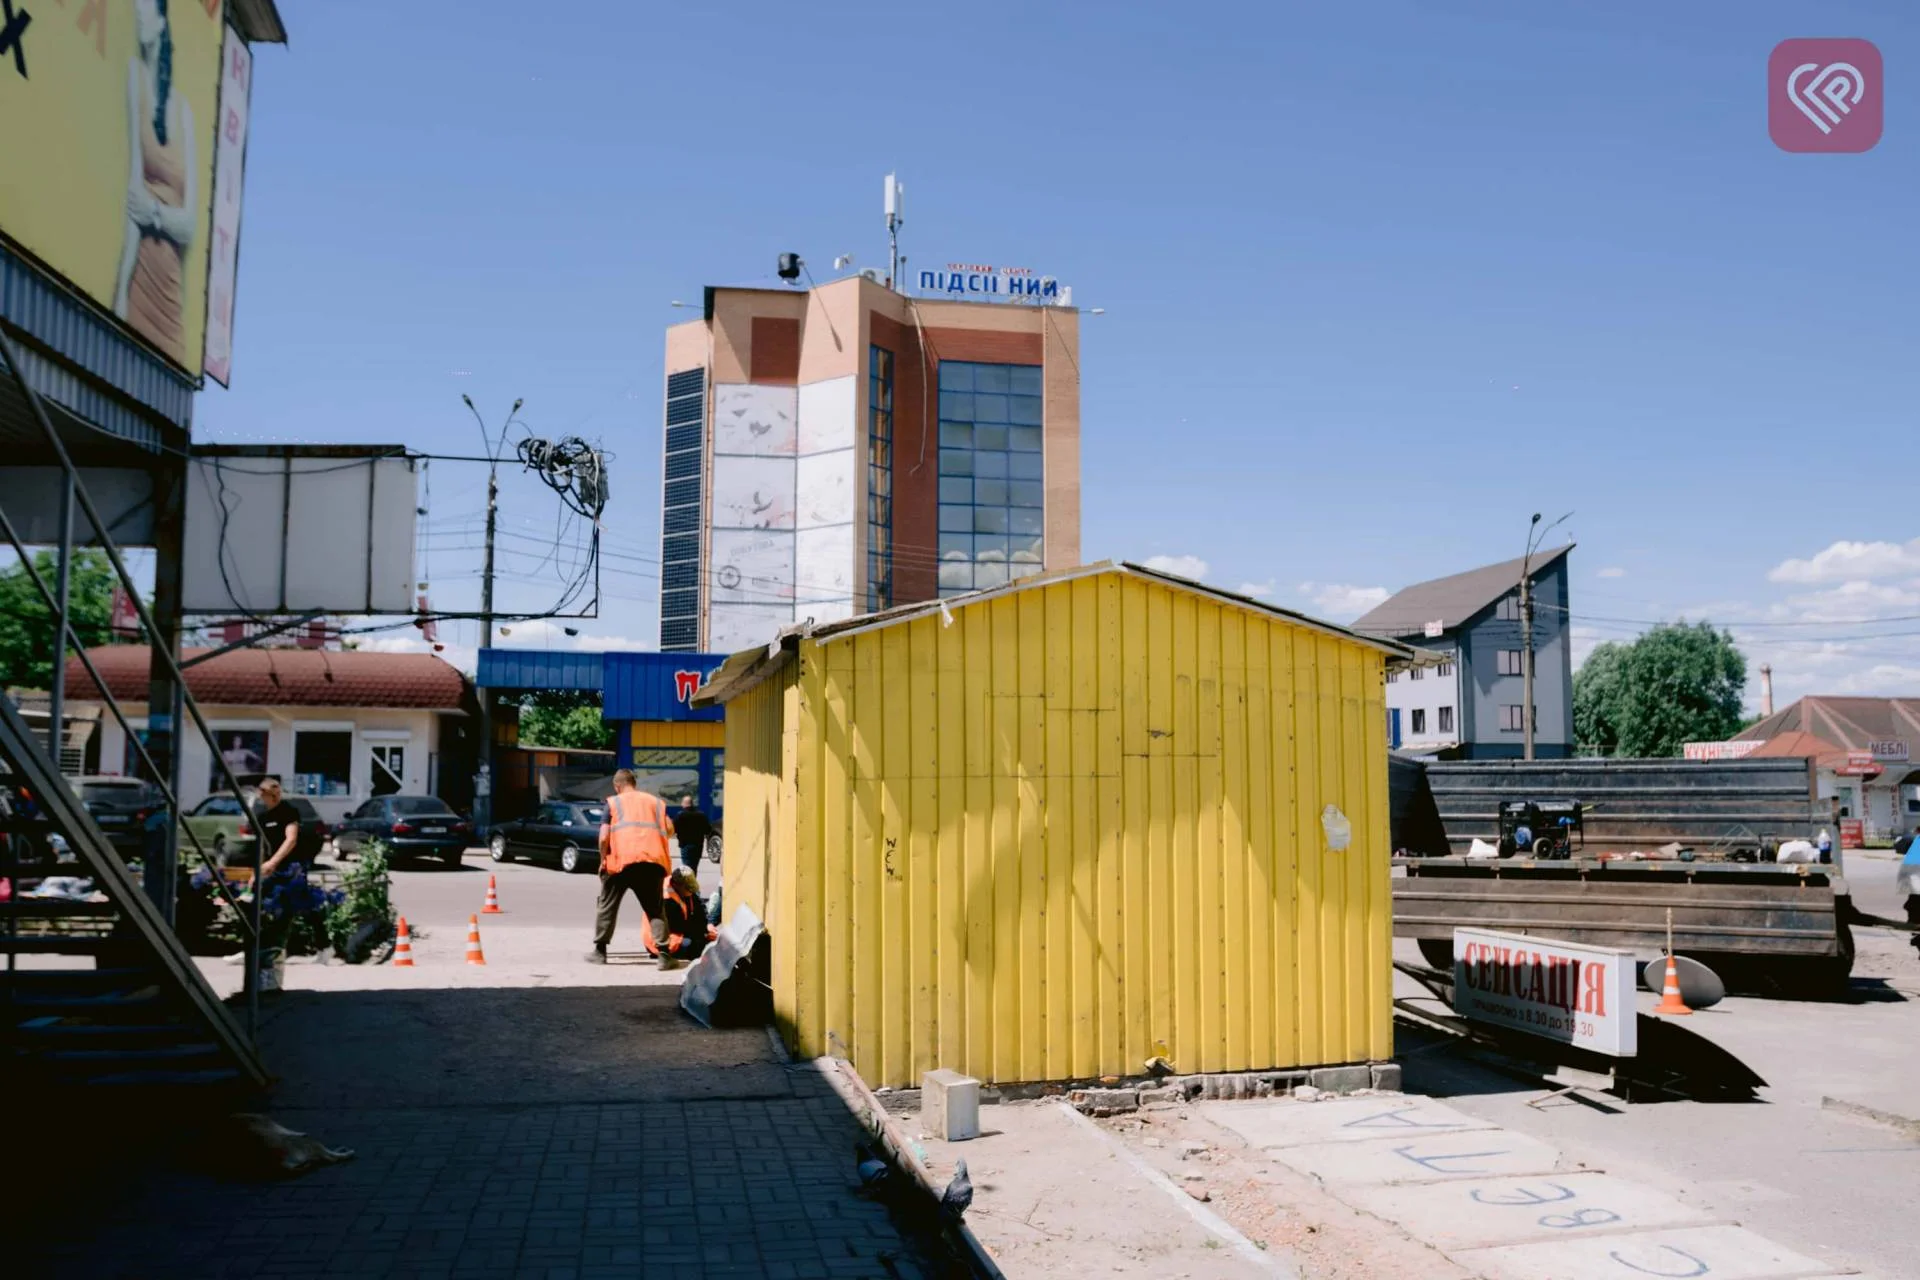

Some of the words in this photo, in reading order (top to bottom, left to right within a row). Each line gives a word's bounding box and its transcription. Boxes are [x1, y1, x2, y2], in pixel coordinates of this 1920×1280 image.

[1871, 742, 1908, 755] МЕБЛІ
[1464, 941, 1606, 1017] СЕНСАЦІЯ
[1526, 1009, 1547, 1026] 8.30
[1549, 1015, 1562, 1030] до
